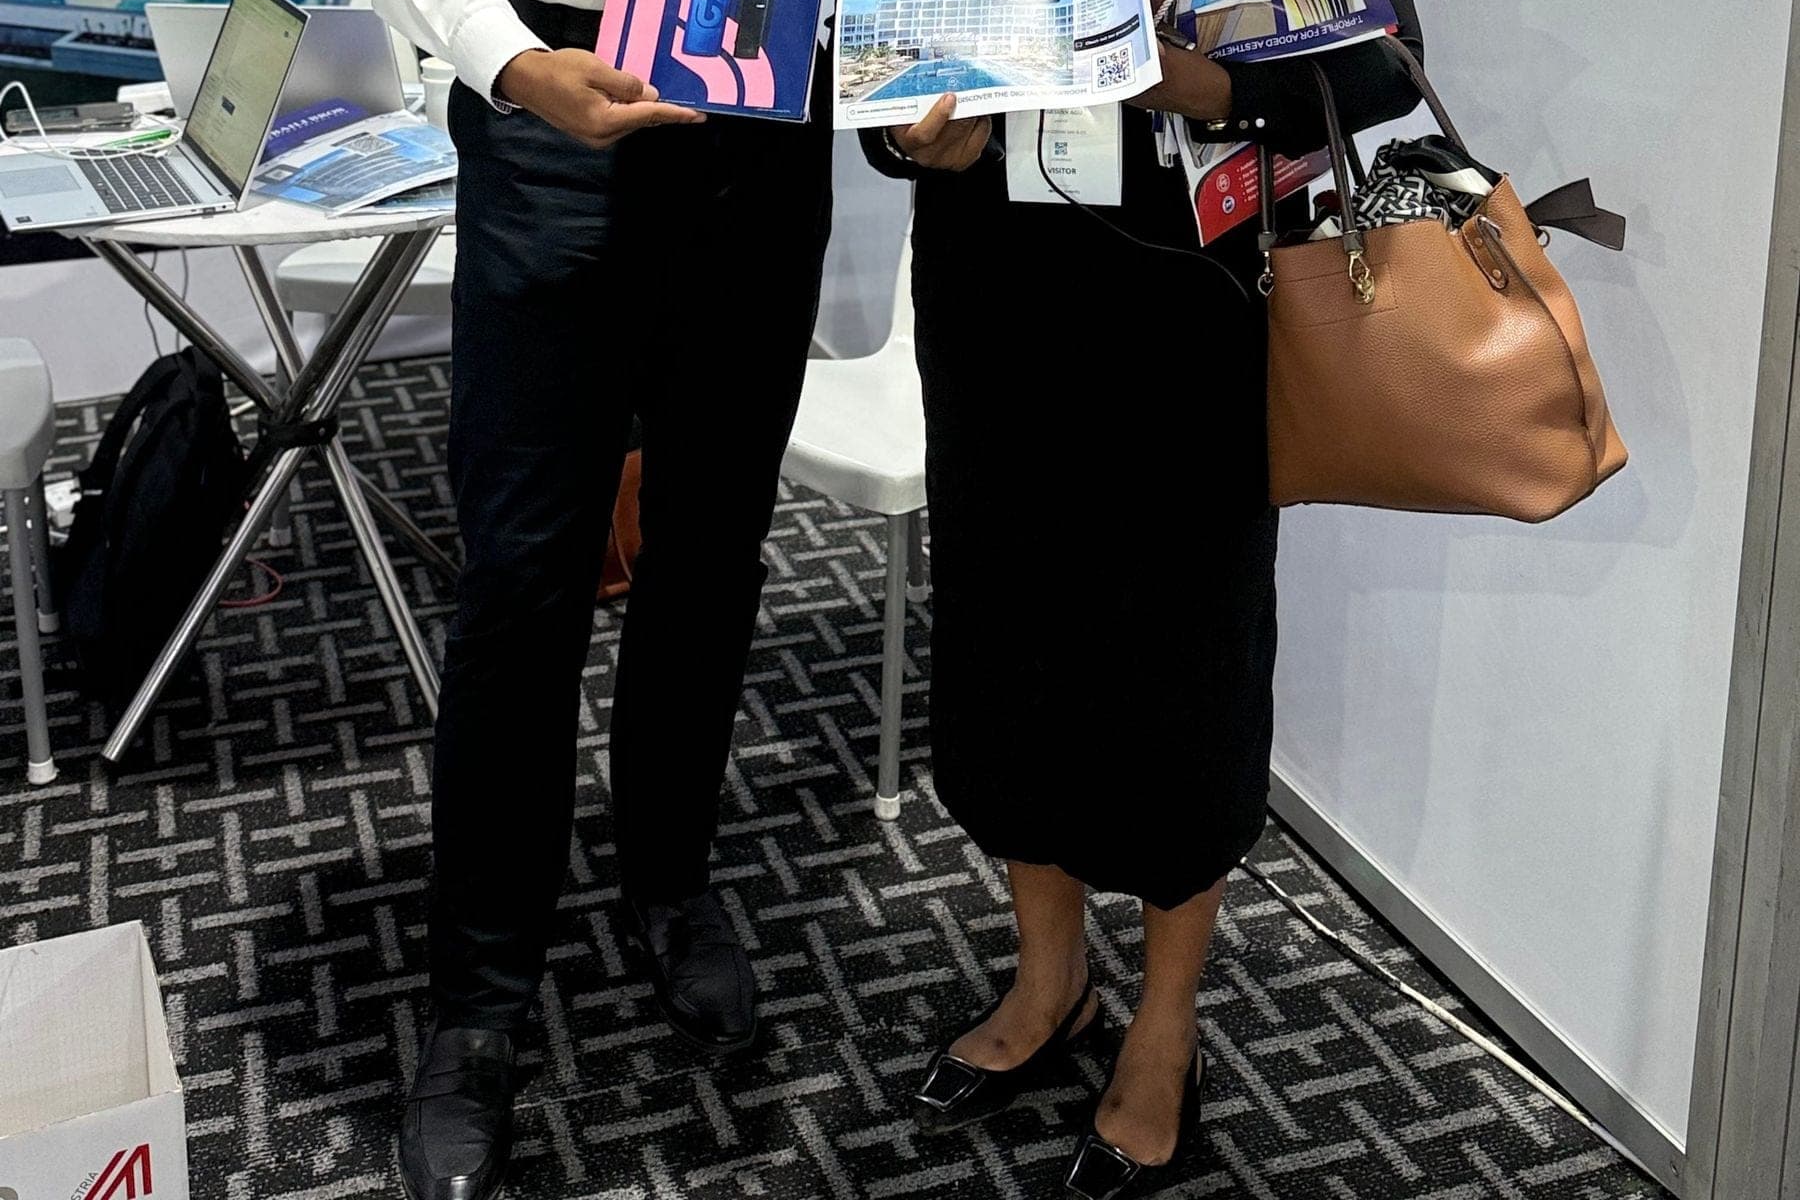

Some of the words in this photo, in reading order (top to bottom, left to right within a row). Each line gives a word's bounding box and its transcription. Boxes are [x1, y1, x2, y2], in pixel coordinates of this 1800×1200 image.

[1322, 15, 1364, 34] T-PROFILE
[1266, 32, 1299, 47] ADDED
[1300, 28, 1320, 40] FOR
[957, 92, 993, 104] DISCOVER
[994, 90, 1009, 99] THE
[1047, 167, 1077, 175] VISITOR
